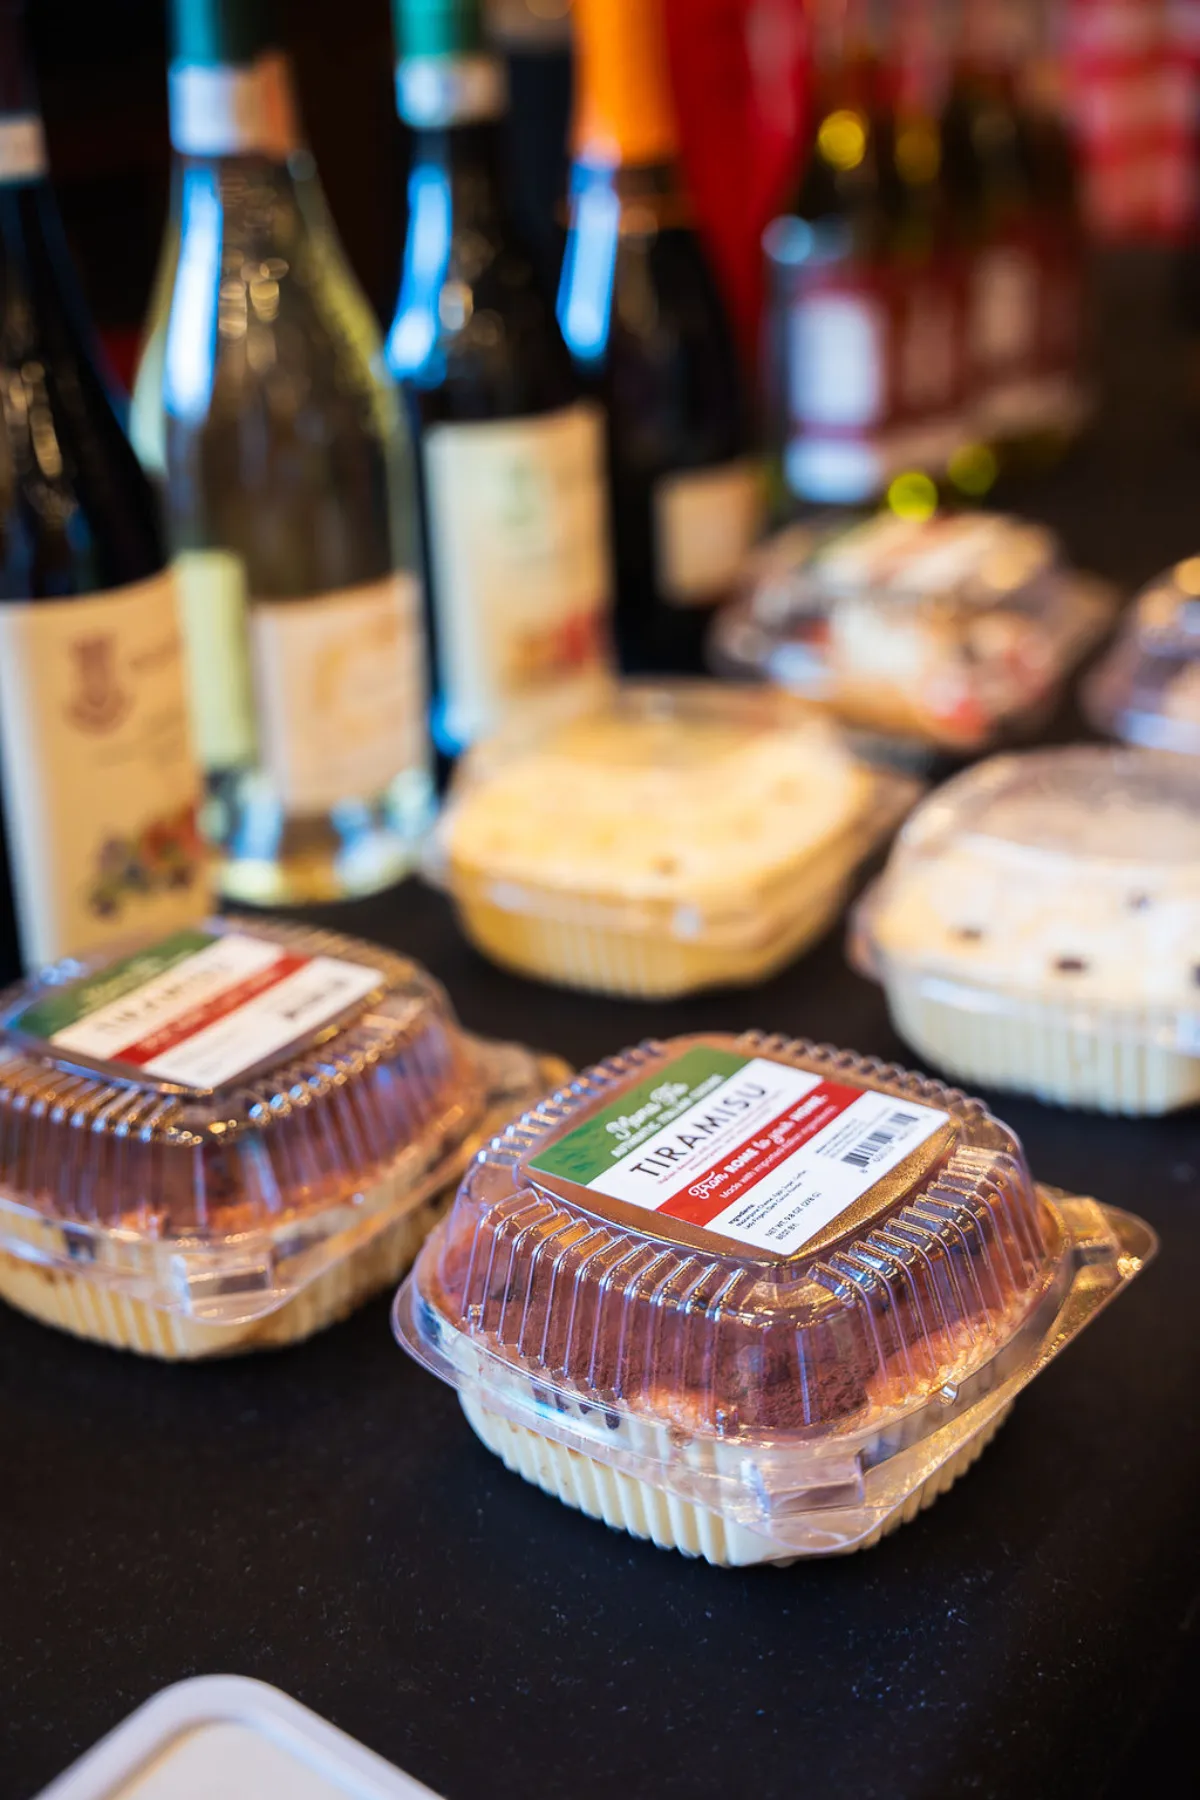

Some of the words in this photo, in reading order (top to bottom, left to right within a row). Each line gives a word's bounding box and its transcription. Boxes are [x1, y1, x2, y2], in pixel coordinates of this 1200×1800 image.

[630, 1082, 766, 1176] TIRAMISU
[689, 1172, 728, 1199] From
[722, 1148, 759, 1174] ROME
[752, 1138, 770, 1149] to
[720, 1182, 743, 1198] Made
[740, 1172, 755, 1183] with
[765, 1227, 777, 1236] NET
